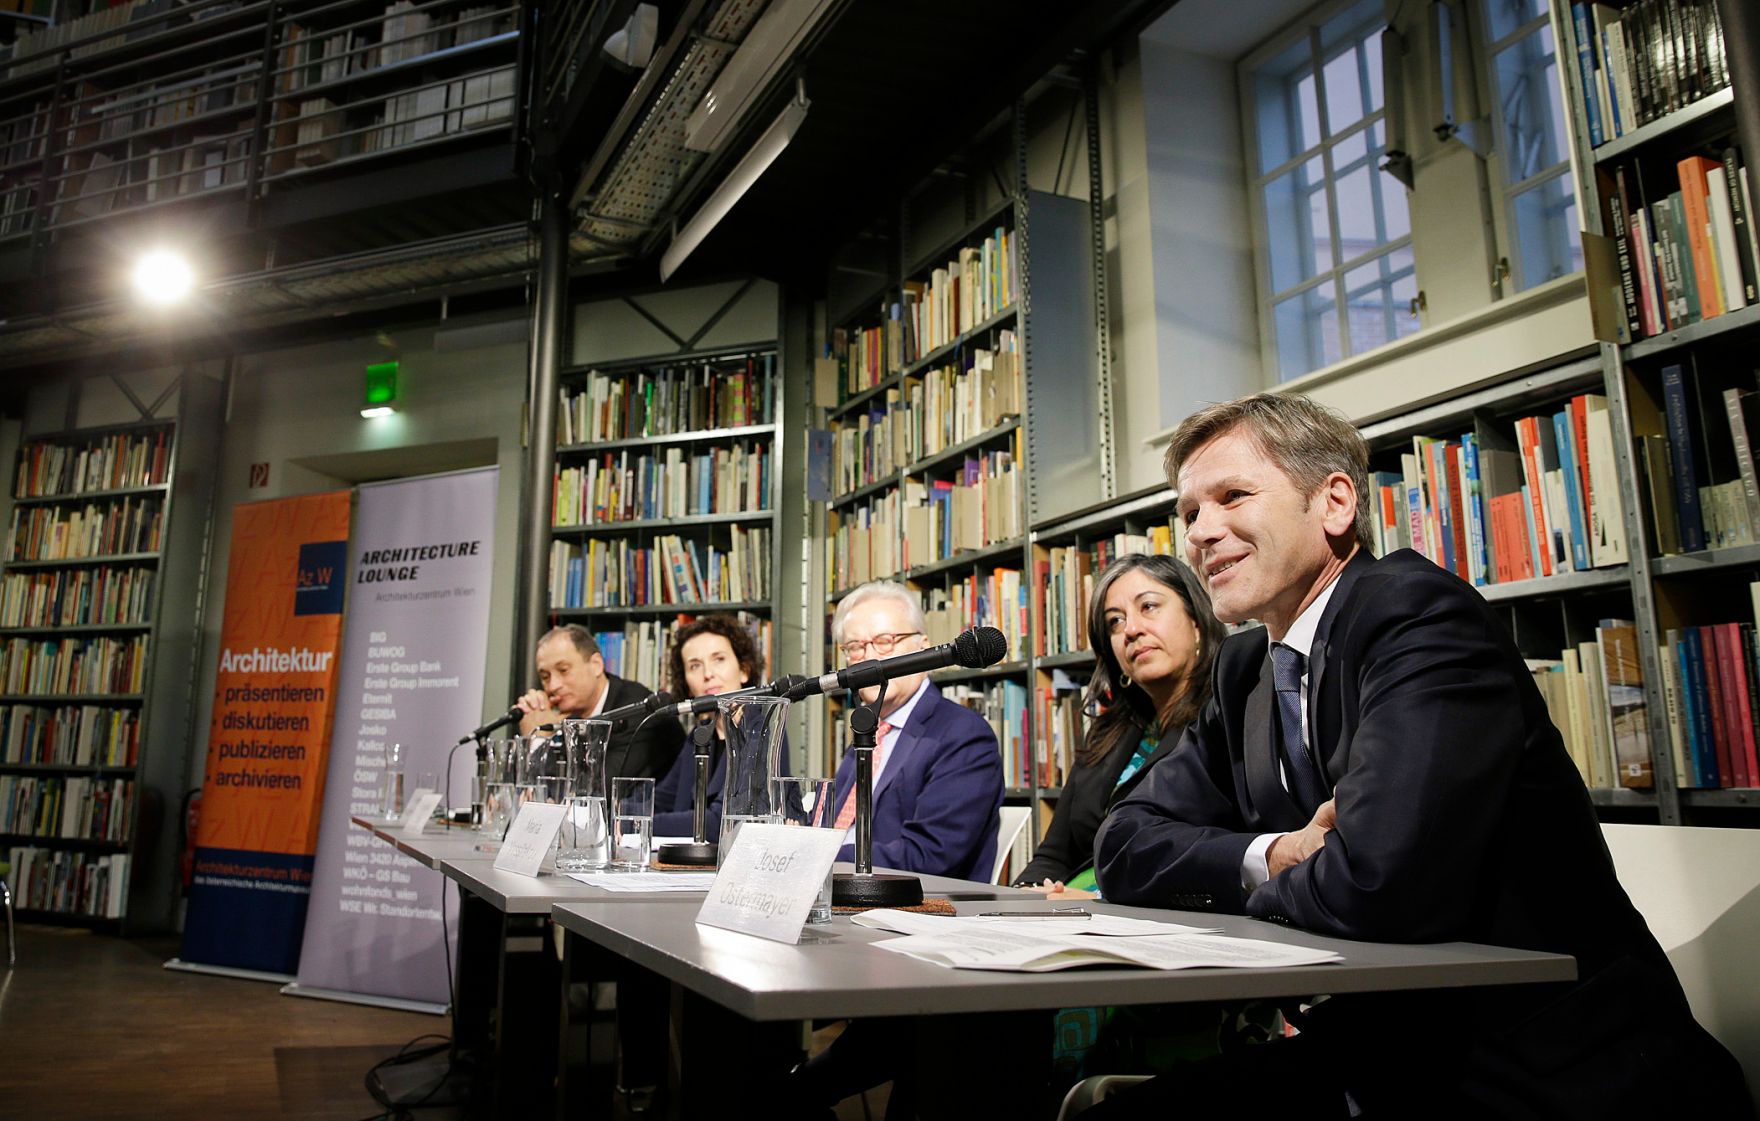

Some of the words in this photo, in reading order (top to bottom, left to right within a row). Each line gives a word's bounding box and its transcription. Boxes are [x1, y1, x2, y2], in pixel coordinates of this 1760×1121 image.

[1736, 435, 1756, 497] CHICAGO
[1592, 511, 1600, 537] AROSA
[360, 541, 481, 565] ARCHITECTURE
[317, 566, 333, 584] W
[357, 565, 420, 584] LOUNGE
[454, 587, 476, 597] Wien
[369, 631, 387, 643] BIG
[220, 646, 333, 673] Architektur
[367, 646, 406, 658] BUWOG
[366, 661, 389, 673] Erste
[390, 661, 419, 674] Group
[419, 660, 441, 672] Bank
[364, 677, 388, 689] Erste
[389, 676, 418, 690] Group
[225, 683, 324, 705] präsentieren
[222, 711, 309, 731] diskutieren
[219, 740, 306, 761] publizieren
[216, 768, 301, 789] archivieren
[344, 850, 369, 864] Wien
[754, 848, 797, 873] Josef
[391, 870, 411, 883] Bau
[720, 881, 797, 919] Ostermayer
